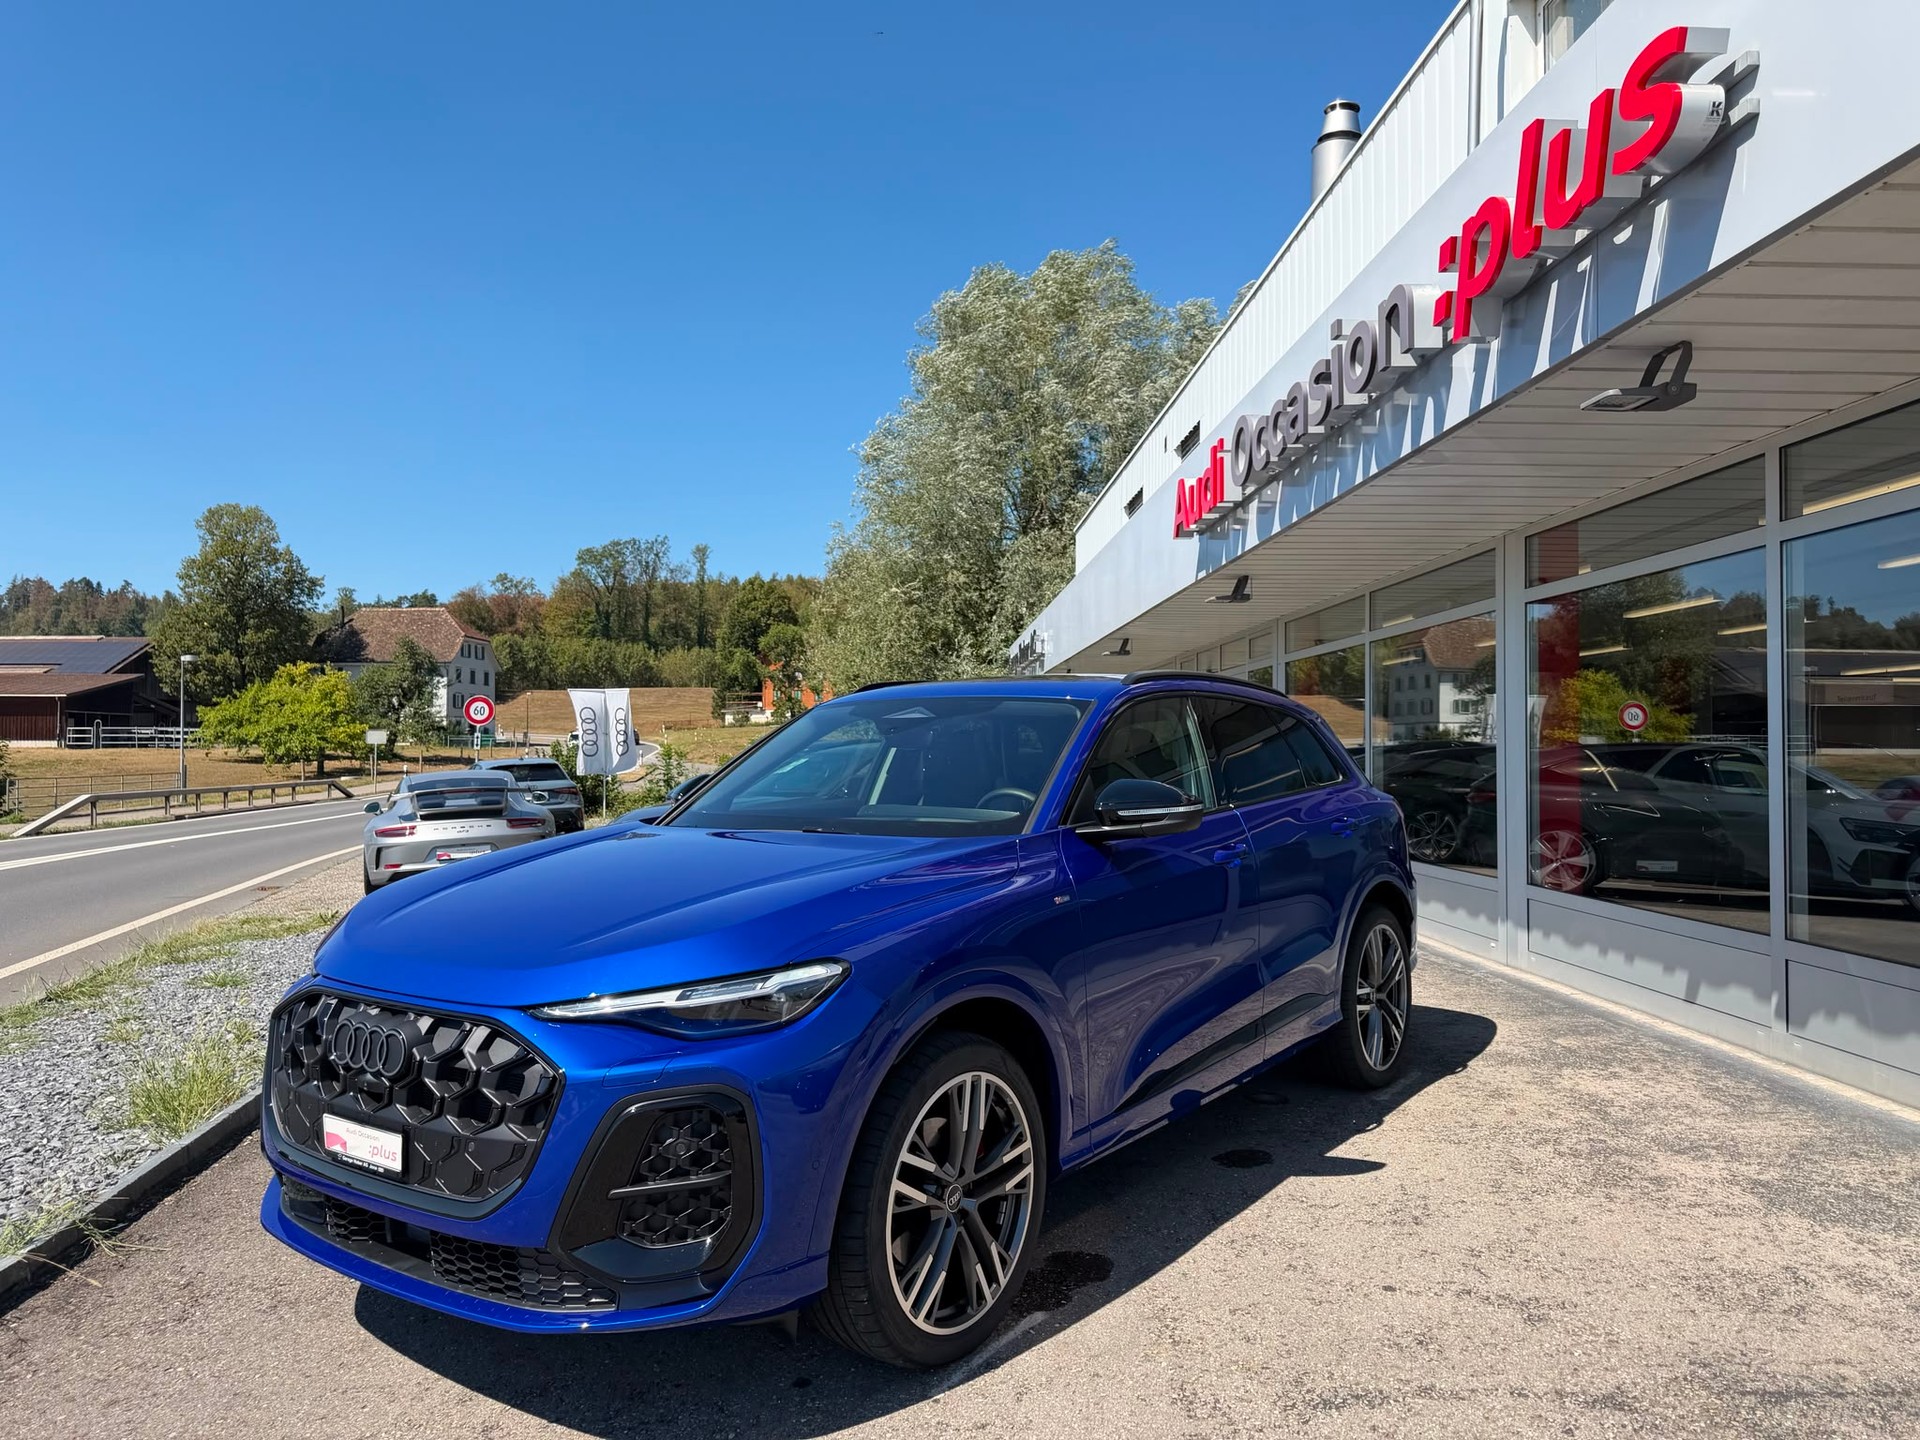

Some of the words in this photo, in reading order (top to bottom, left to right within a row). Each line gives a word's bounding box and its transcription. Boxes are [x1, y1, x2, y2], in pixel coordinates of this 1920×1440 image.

[1173, 438, 1224, 540] Audi
[1231, 284, 1414, 486] Occasion
[1432, 26, 1689, 344] :plus
[473, 705, 486, 716] 60
[368, 1144, 398, 1162] :plus
